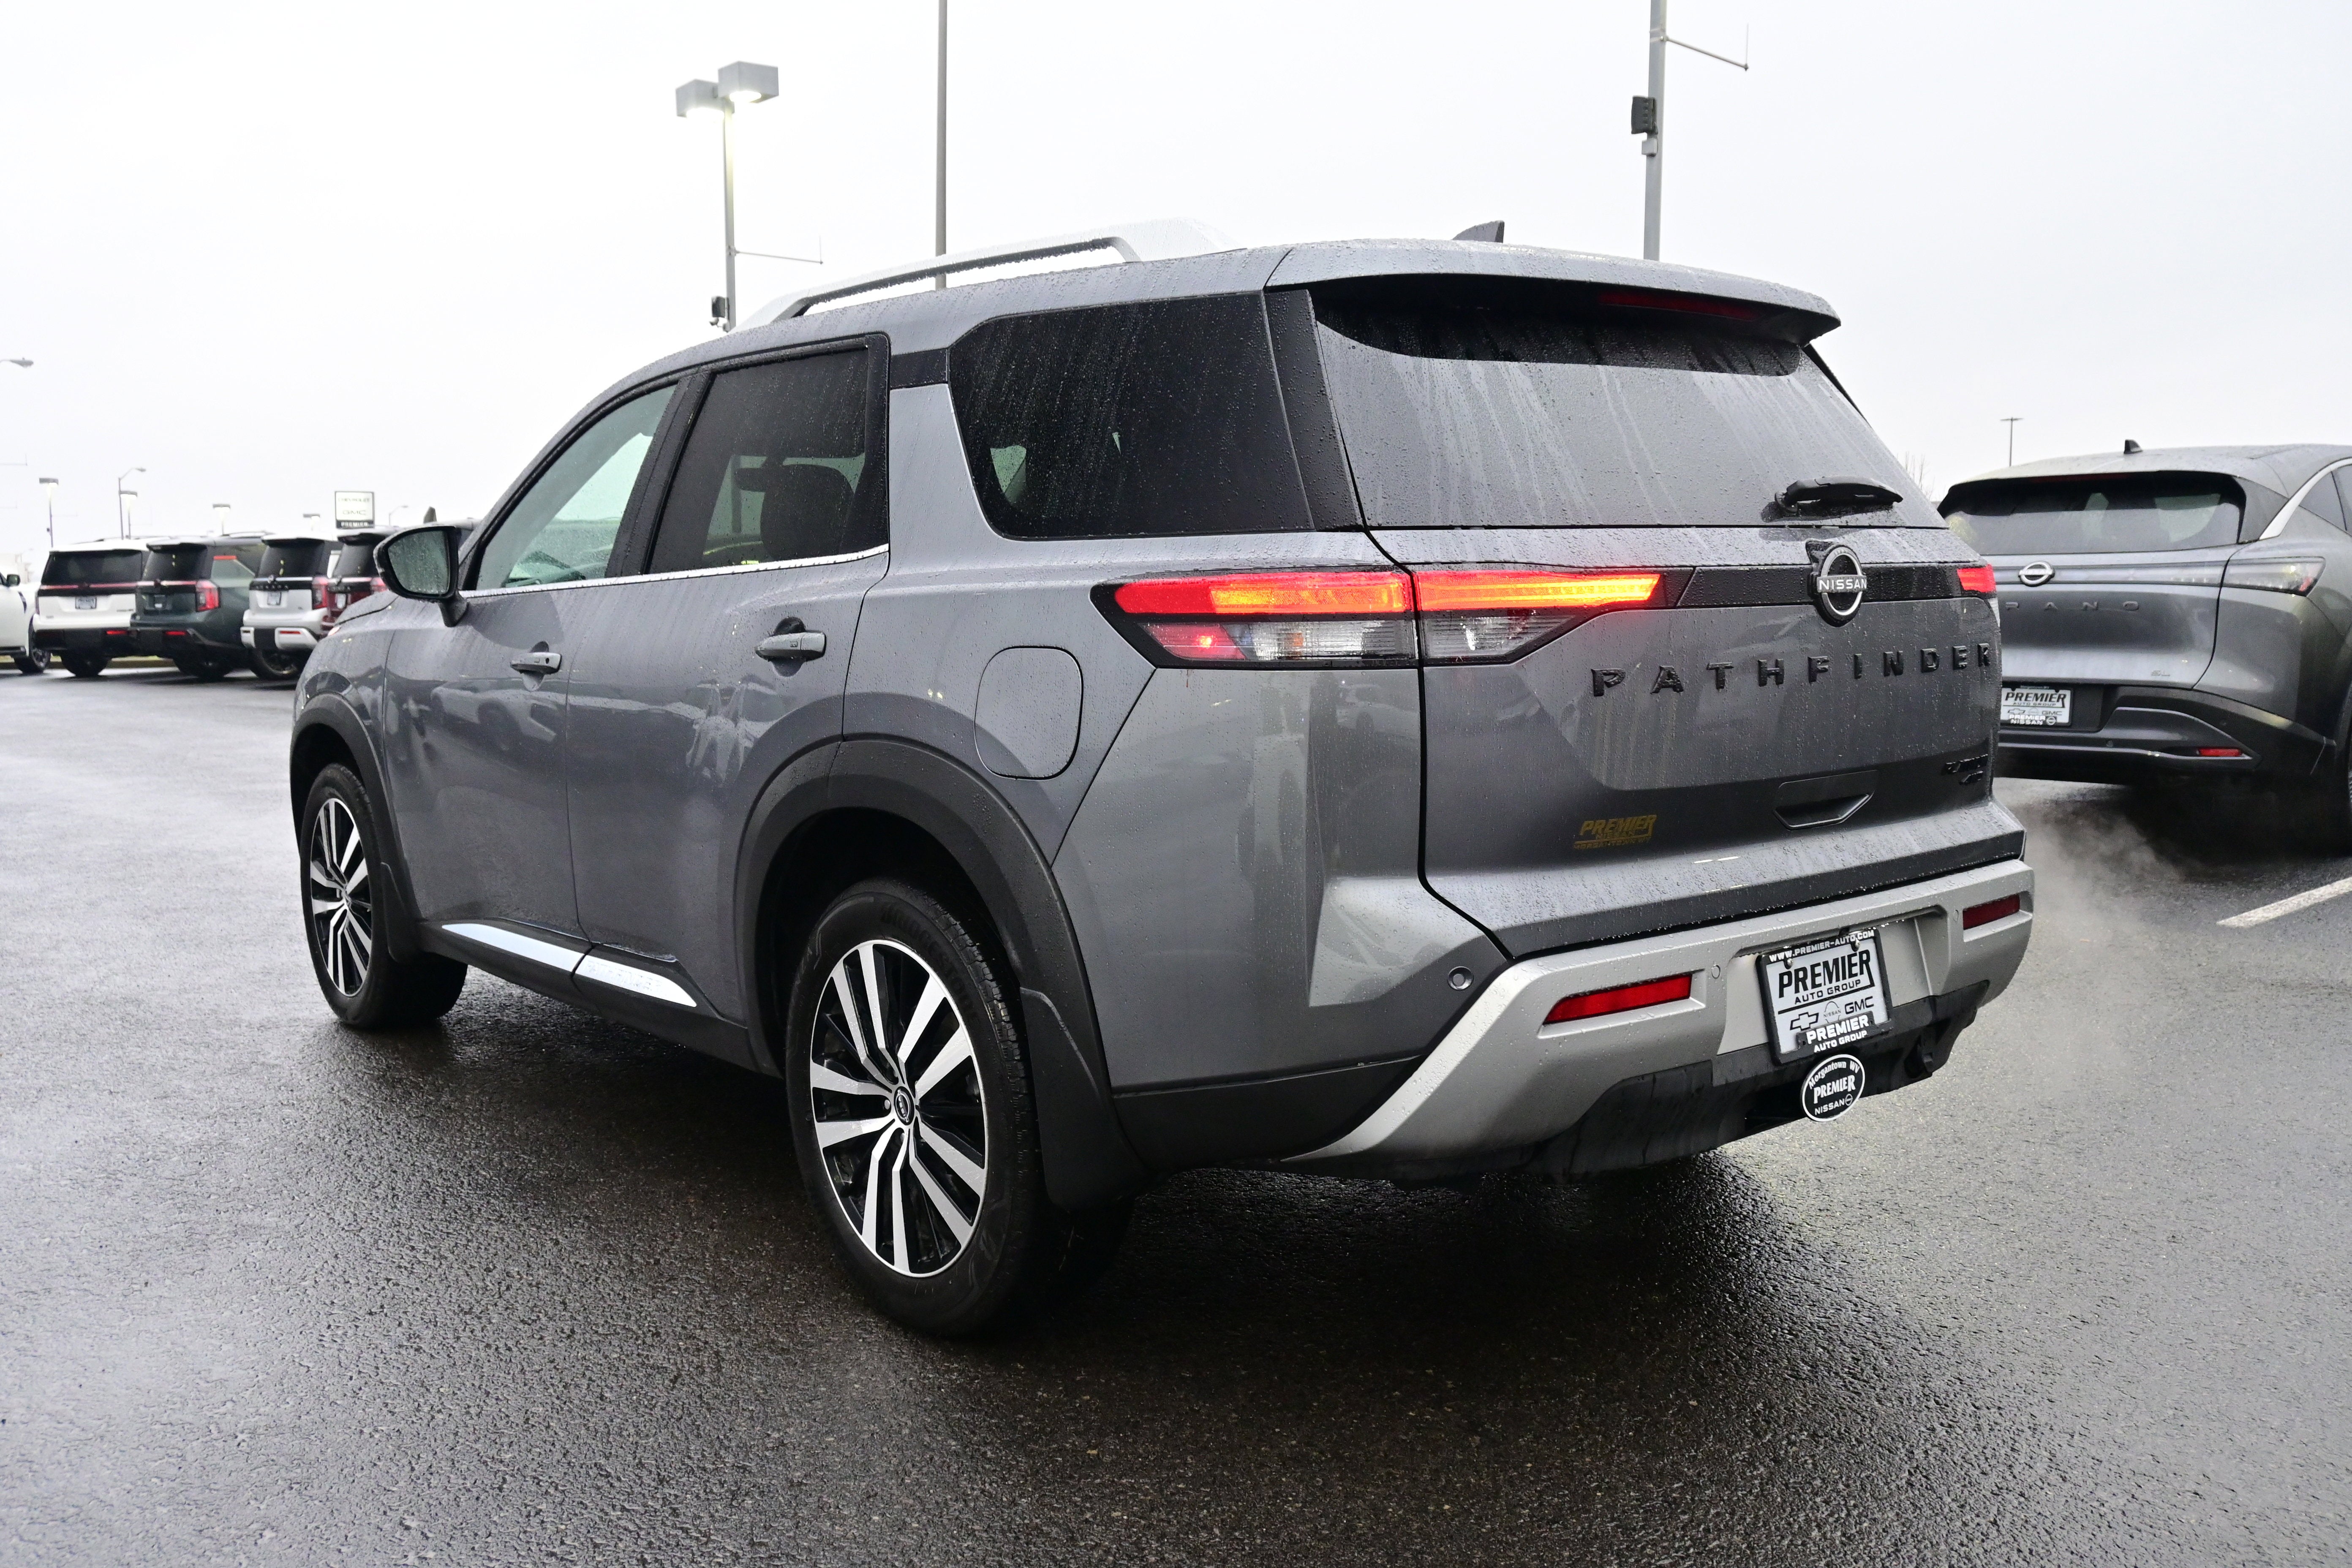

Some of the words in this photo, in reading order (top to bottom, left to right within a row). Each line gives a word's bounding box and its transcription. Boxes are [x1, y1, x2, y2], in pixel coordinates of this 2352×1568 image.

[1818, 578, 1867, 590] NISSAN
[1590, 642, 1990, 697] PATHFINDER
[2005, 692, 2067, 708] PREMIER
[1579, 814, 1657, 836] PREMIER
[1778, 949, 1875, 998] PREMIER
[1795, 991, 1823, 1004] AUTO
[1827, 979, 1861, 995] GROUP
[1823, 1009, 1841, 1018] NISSAN
[1844, 996, 1874, 1015] GMC
[1806, 1014, 1869, 1045] PREMIER
[1814, 1040, 1837, 1053] AUTO
[1838, 1030, 1867, 1045] GROUP
[1808, 1061, 1847, 1090] Morgantown
[1849, 1060, 1860, 1074] WV
[1813, 1075, 1856, 1104] PREMIER
[1814, 1098, 1845, 1116] NISSAN
